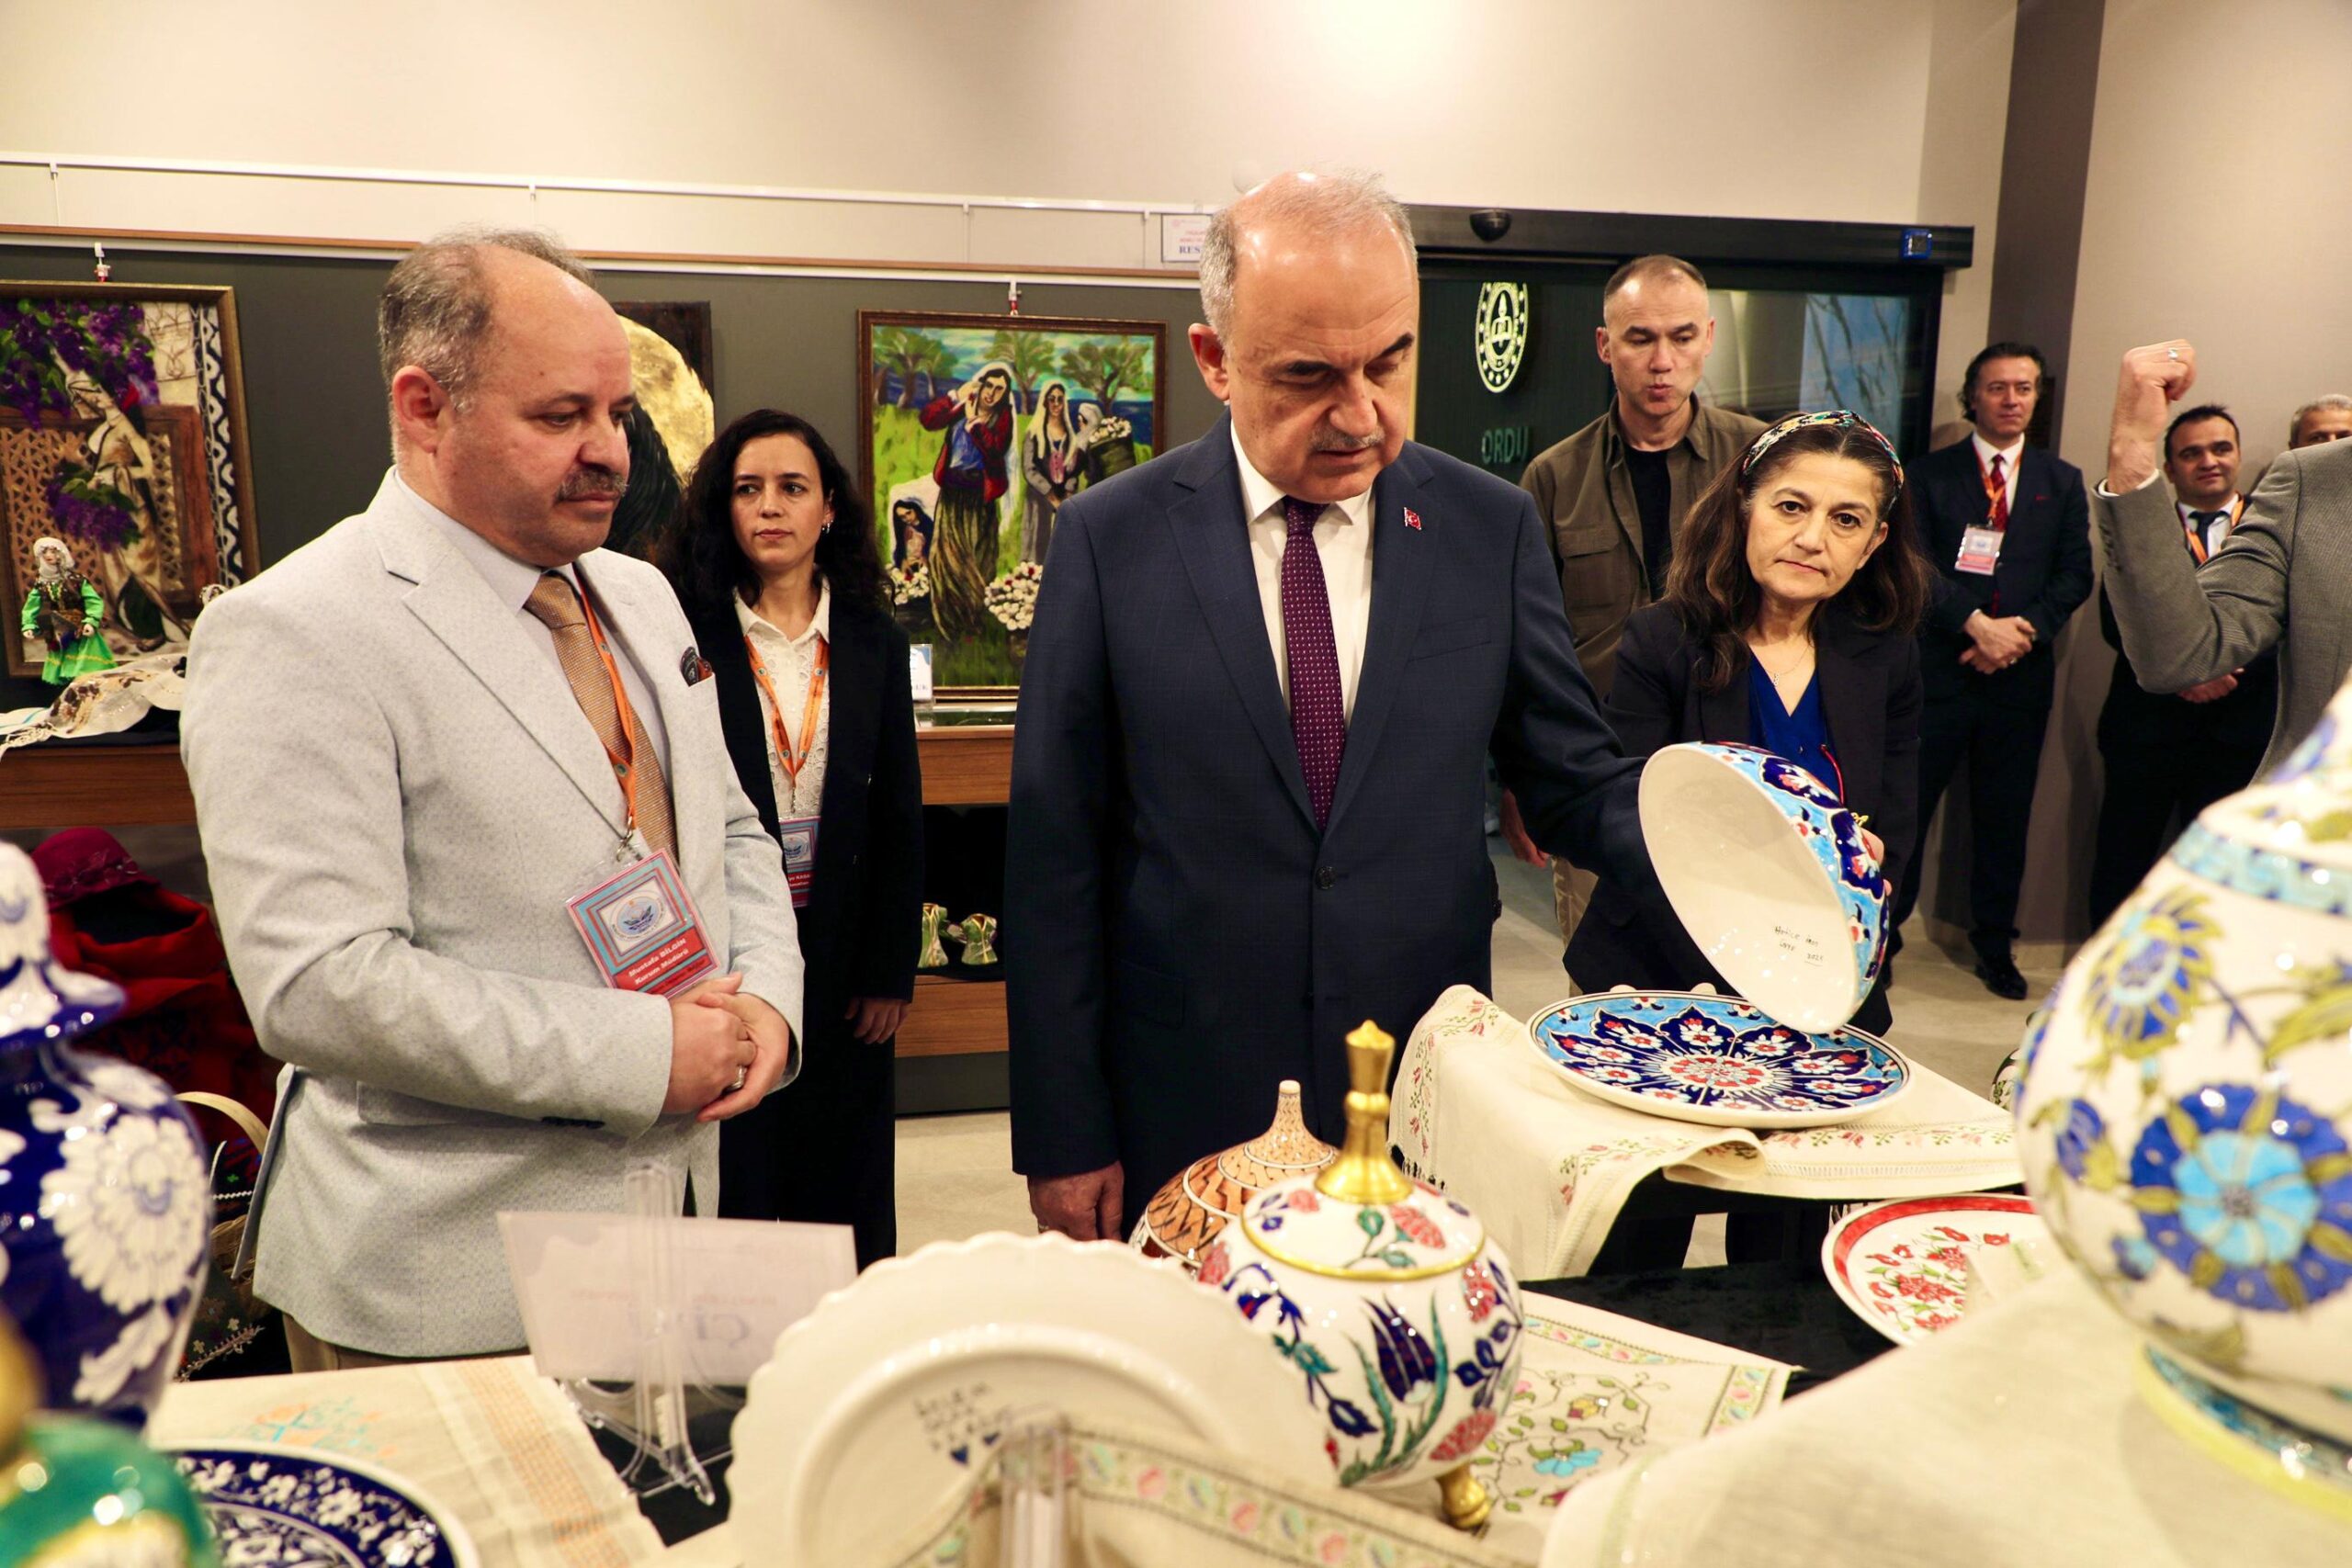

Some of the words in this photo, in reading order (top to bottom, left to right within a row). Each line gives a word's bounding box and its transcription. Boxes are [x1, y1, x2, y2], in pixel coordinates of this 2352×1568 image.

[1482, 425, 1530, 465] ORDU
[628, 955, 660, 977] Mustafa
[635, 966, 661, 986] Kurum
[661, 947, 690, 969] Müdürü
